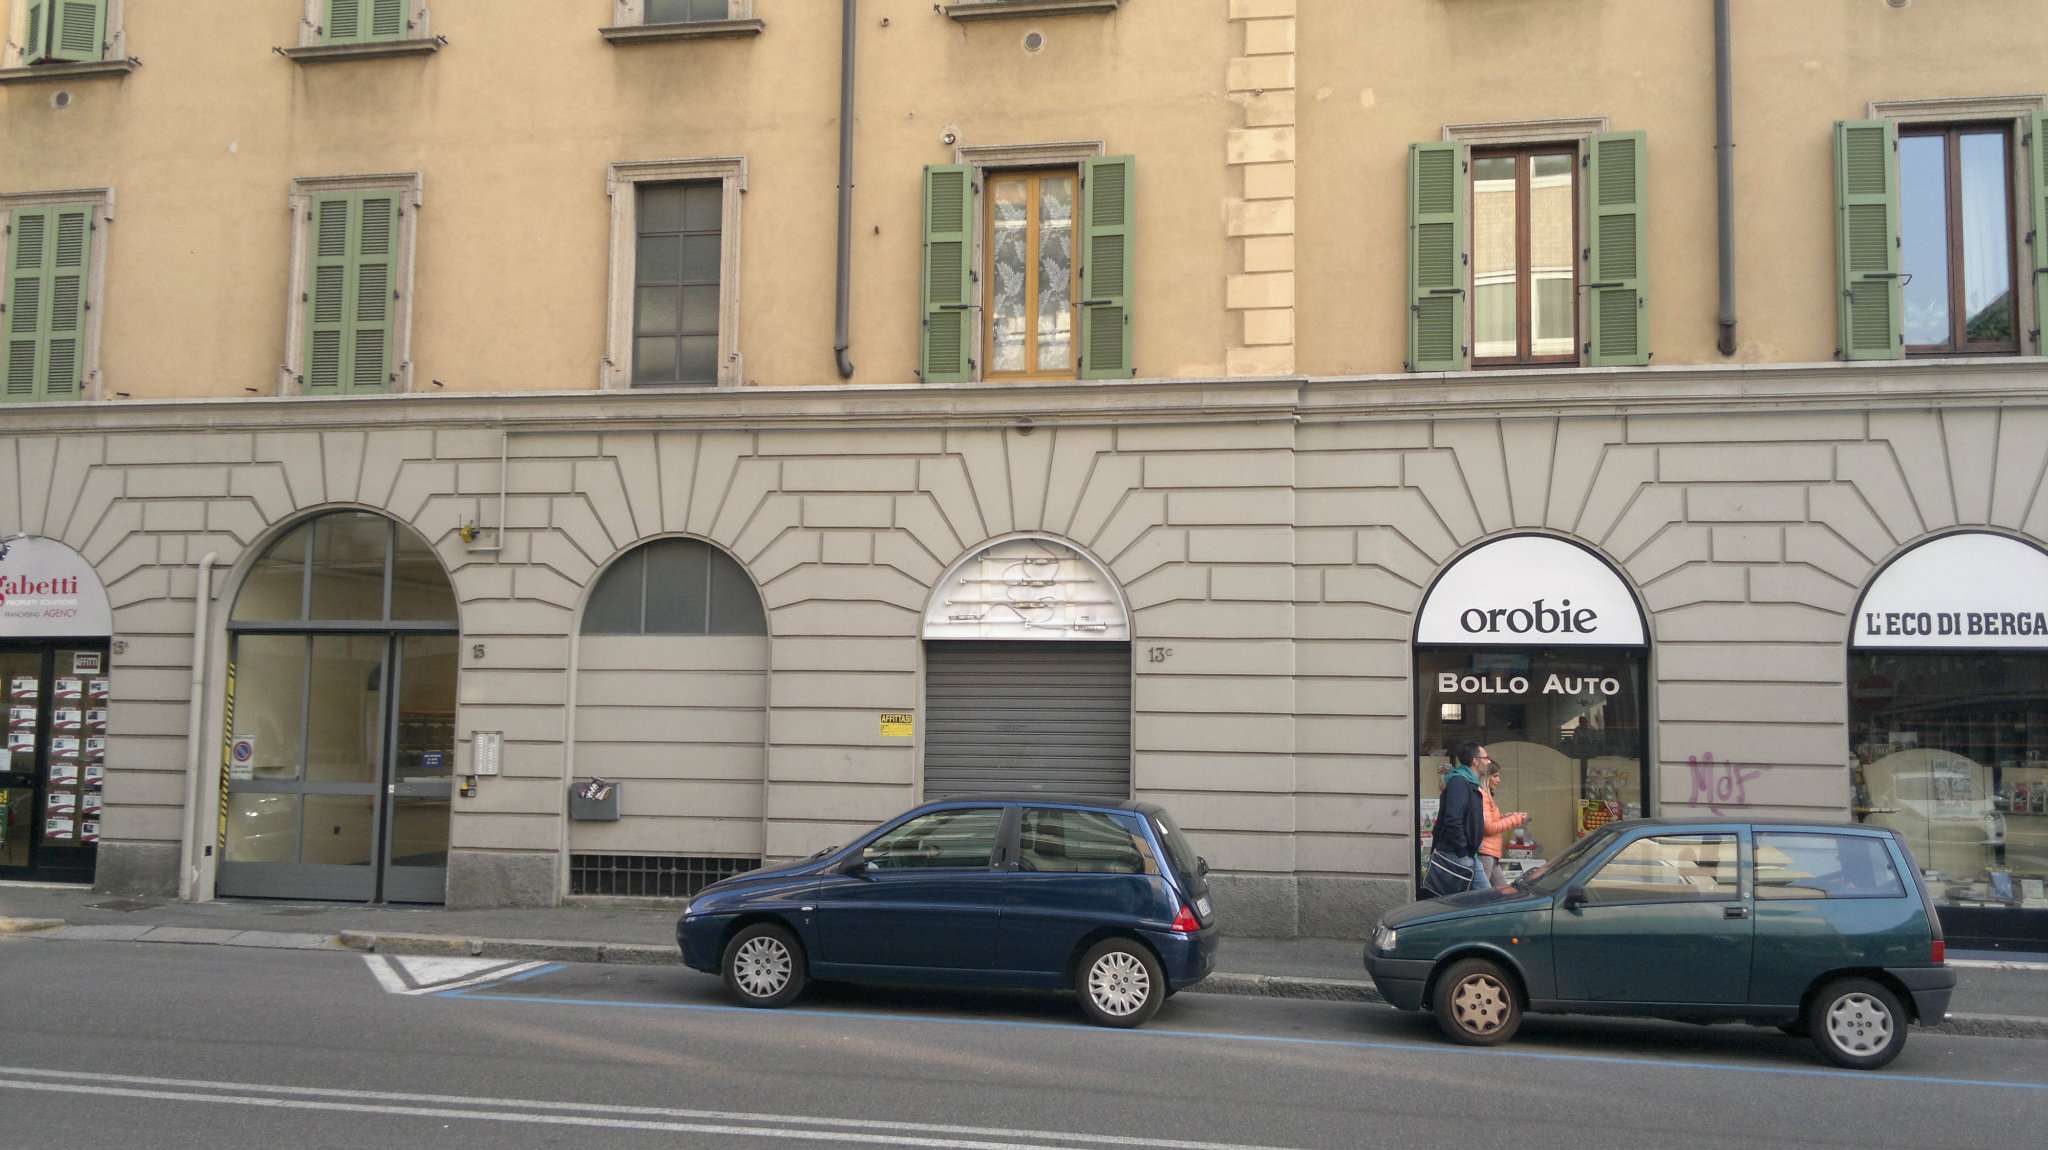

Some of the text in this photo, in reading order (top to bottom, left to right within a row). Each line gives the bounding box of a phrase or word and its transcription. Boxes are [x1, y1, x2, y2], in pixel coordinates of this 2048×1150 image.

[43, 608, 77, 618] AGENCY
[1460, 599, 1598, 633] orobie
[1866, 612, 1932, 635] L'ECO
[1937, 612, 1962, 635] DI
[1438, 672, 1620, 695] BOLLO AUTO
